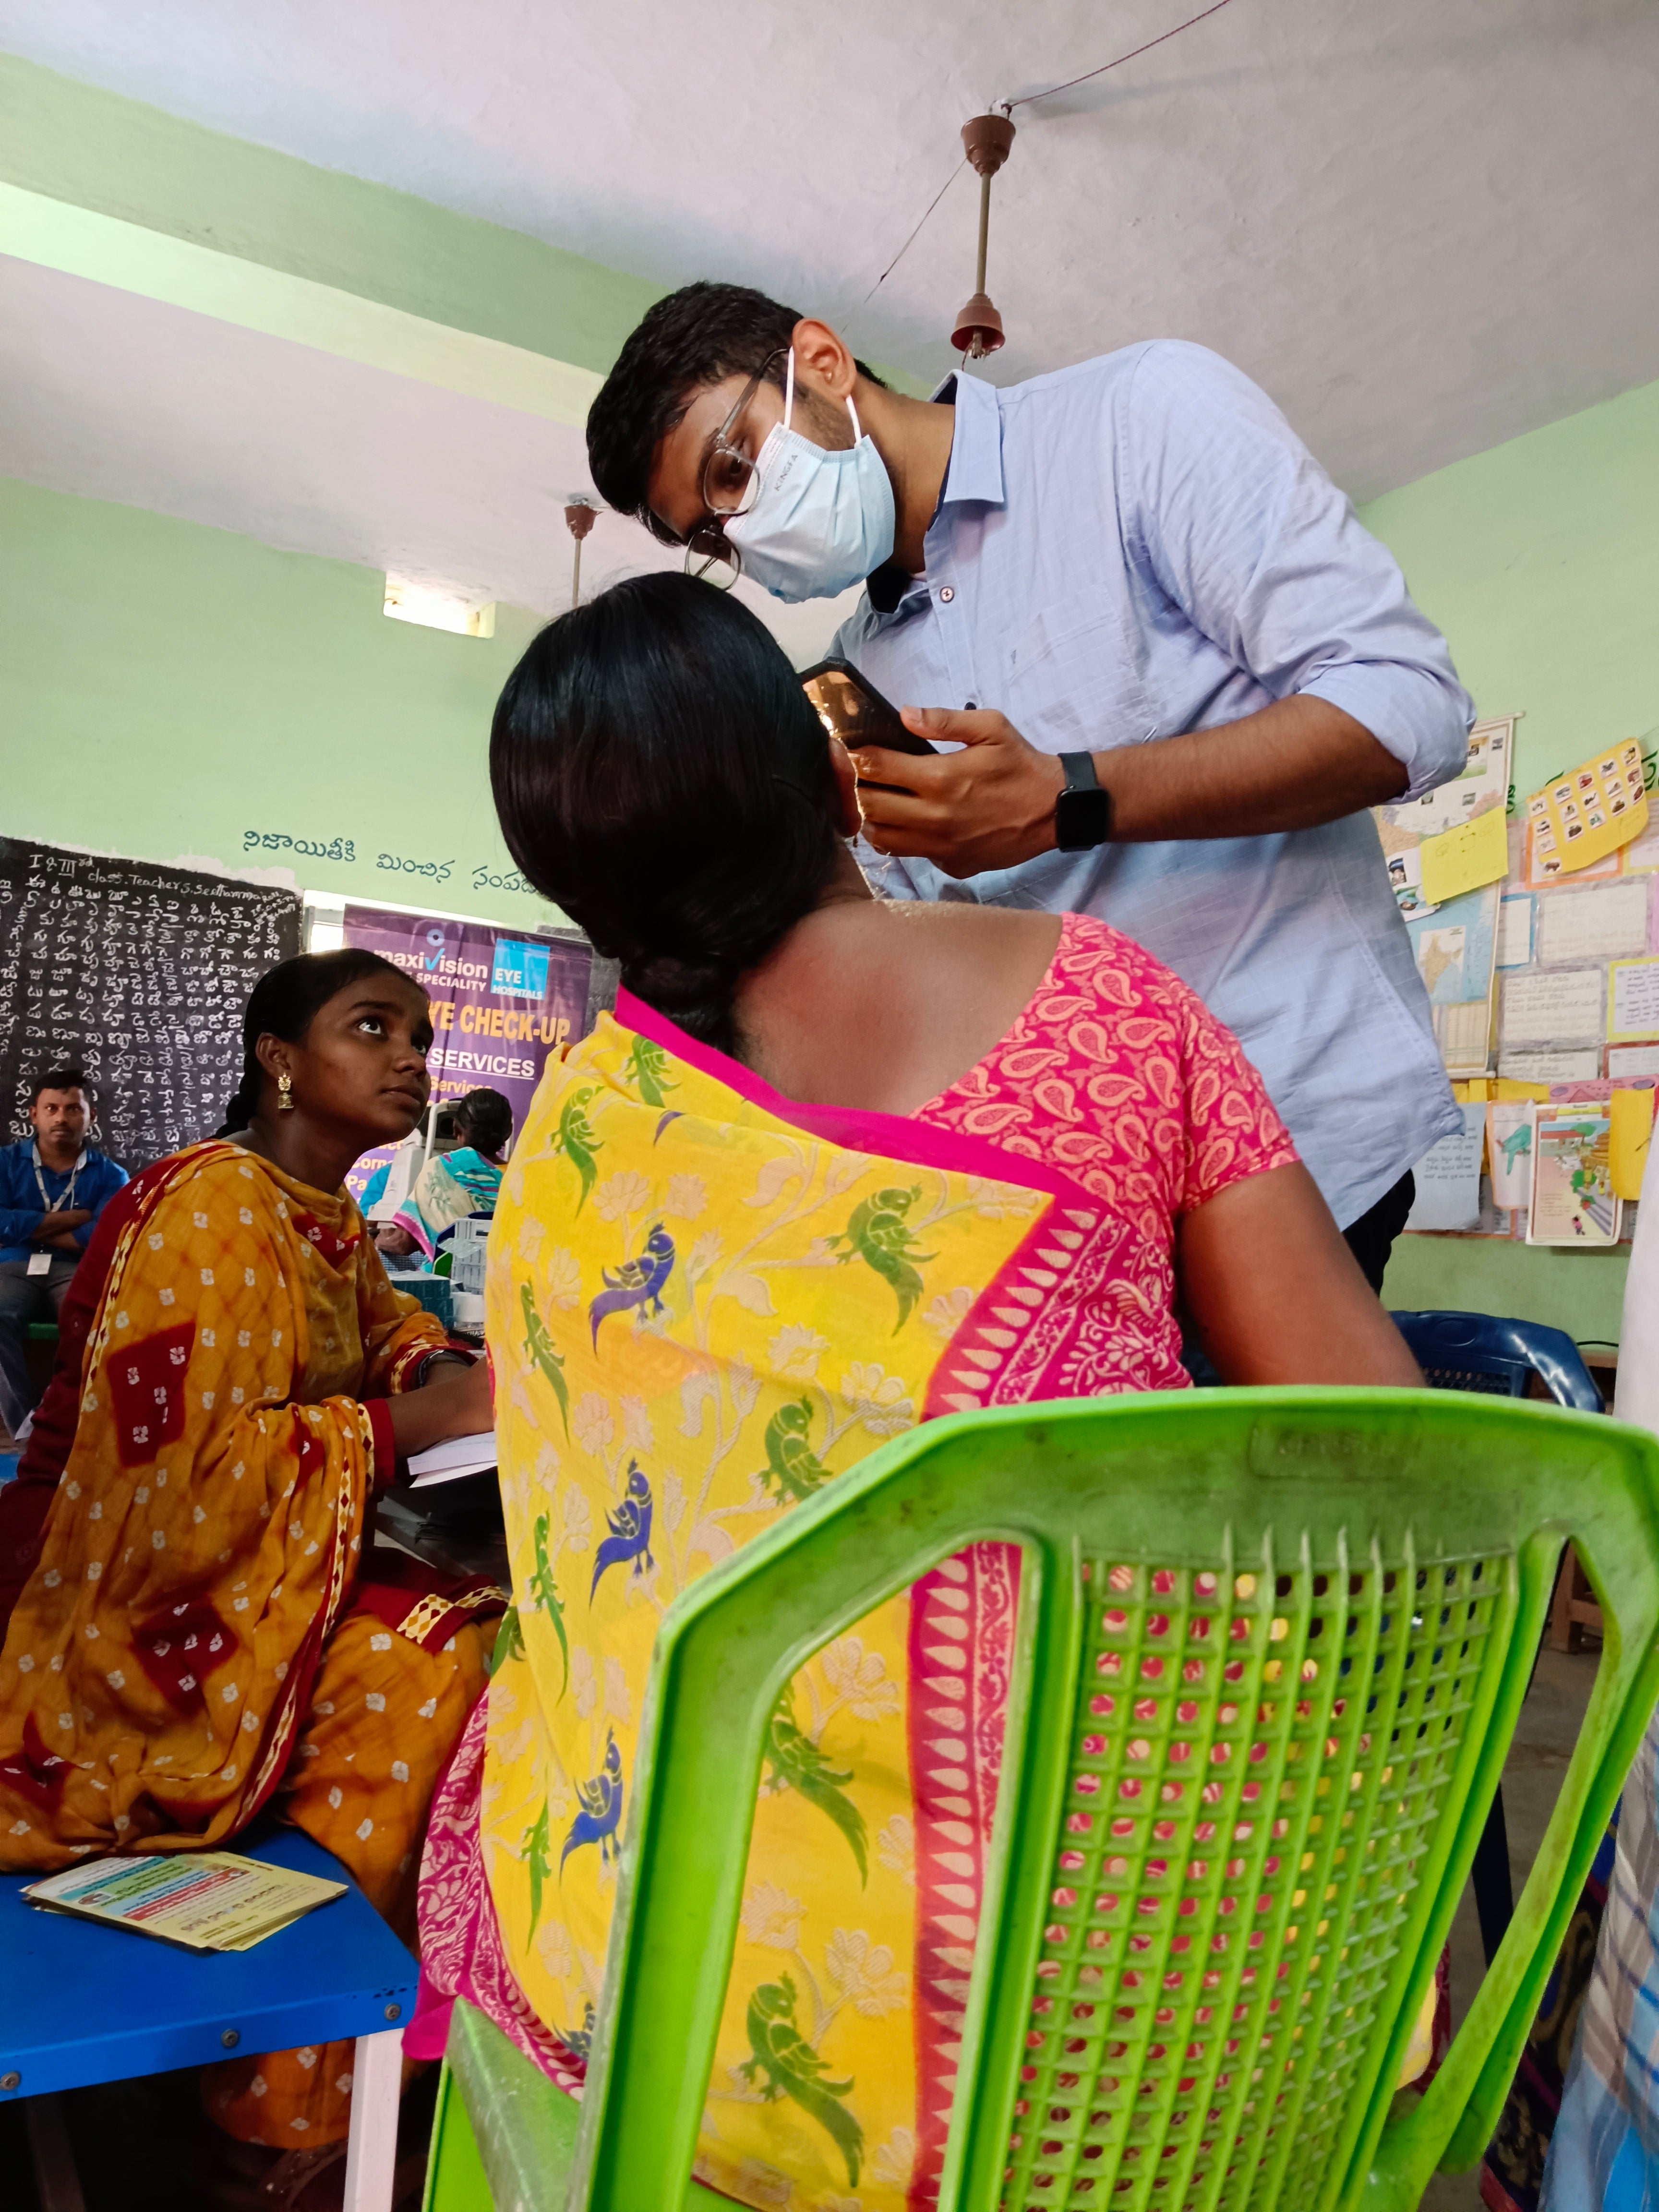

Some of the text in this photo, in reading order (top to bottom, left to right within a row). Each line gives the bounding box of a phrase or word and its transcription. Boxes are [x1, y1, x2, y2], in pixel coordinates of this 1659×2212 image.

[774, 454, 798, 491] KINGFA
[244, 830, 356, 862] నిజాయితీకి
[376, 854, 455, 883] మించిన
[416, 973, 486, 992] SPECIALITY
[495, 968, 522, 984] EYE
[493, 985, 543, 1000] HOSPITALS
[428, 1000, 570, 1046] YE CHECK-UP
[430, 1048, 535, 1077] SERVICES
[431, 1075, 492, 1094] Servic
